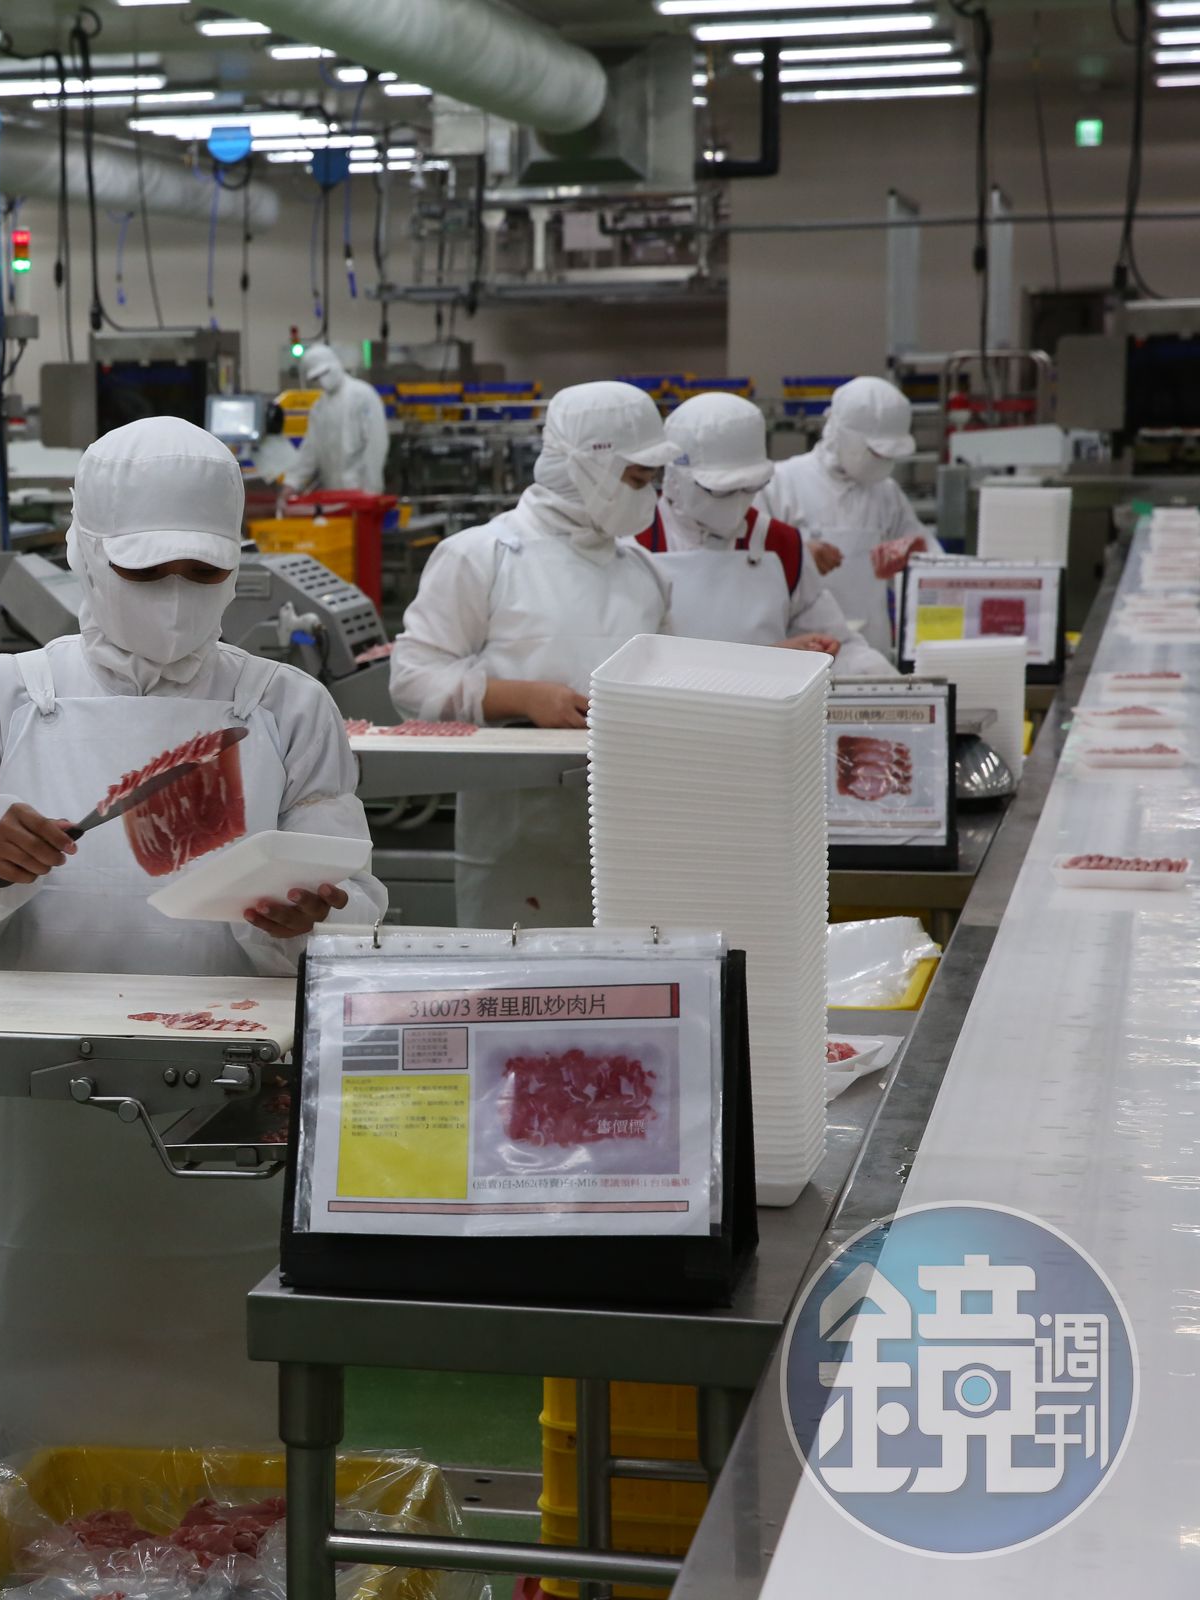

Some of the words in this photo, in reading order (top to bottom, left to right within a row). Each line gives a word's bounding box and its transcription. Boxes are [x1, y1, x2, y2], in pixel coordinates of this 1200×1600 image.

[409, 999, 471, 1018] 310073
[476, 993, 606, 1017] 豬里肌炒肉片
